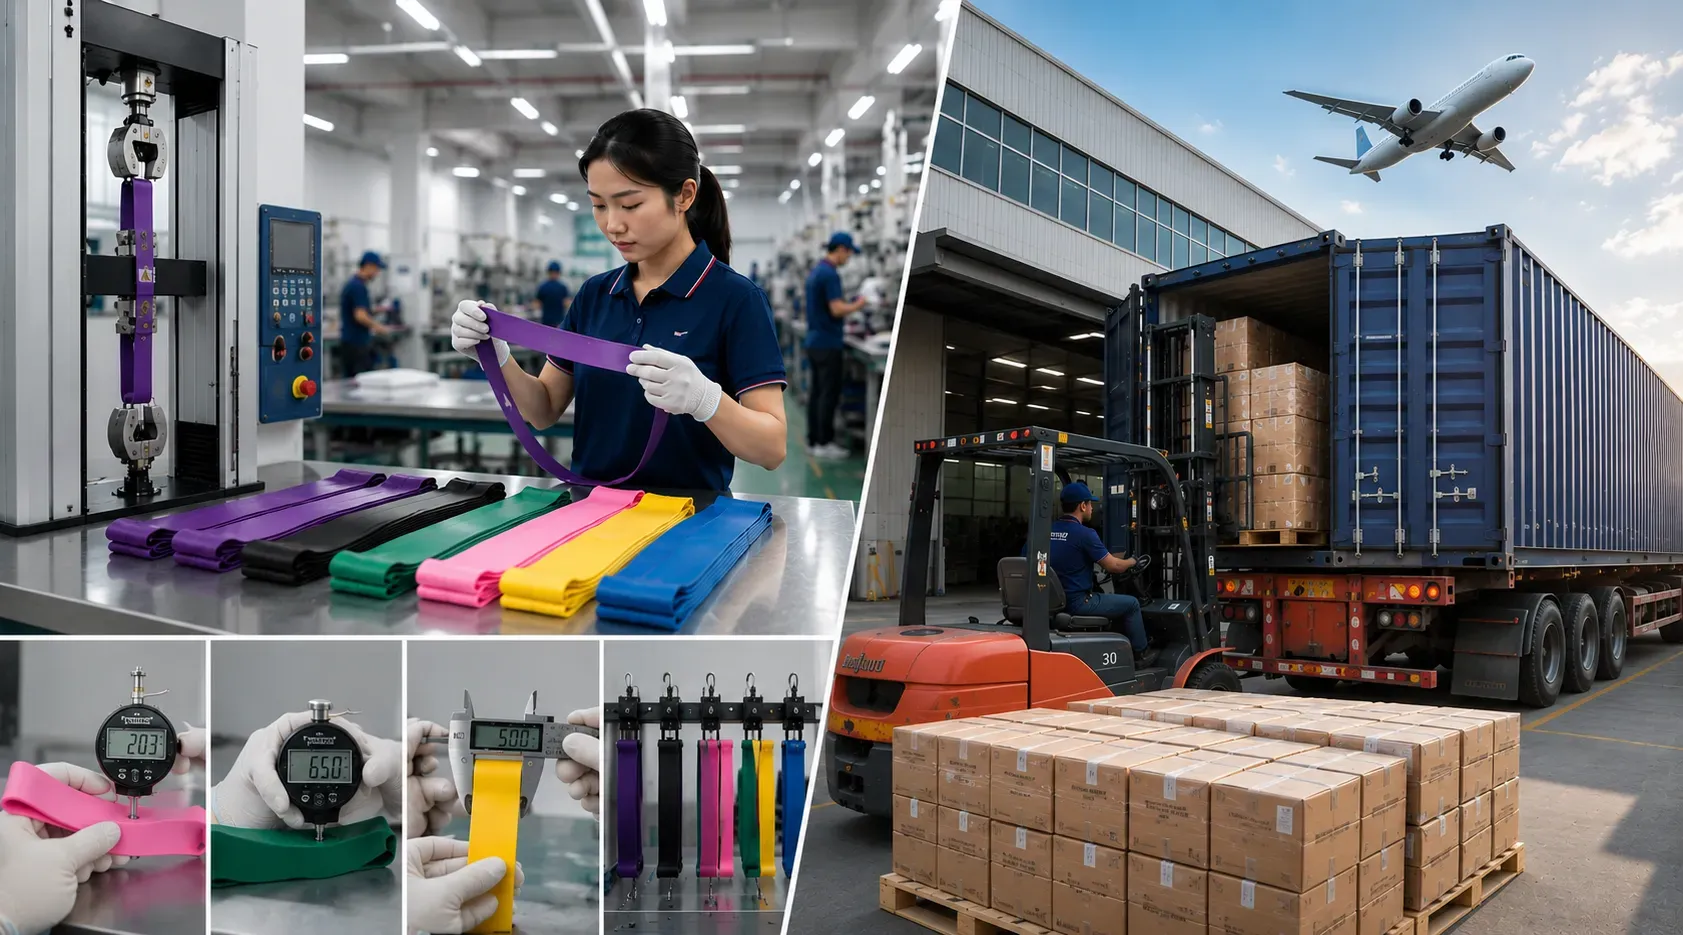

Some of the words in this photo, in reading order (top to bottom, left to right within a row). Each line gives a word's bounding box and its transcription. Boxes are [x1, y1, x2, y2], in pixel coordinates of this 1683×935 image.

[1102, 652, 1117, 665] 30
[127, 733, 158, 755] 203
[498, 728, 530, 748] 500
[309, 755, 342, 780] 650
